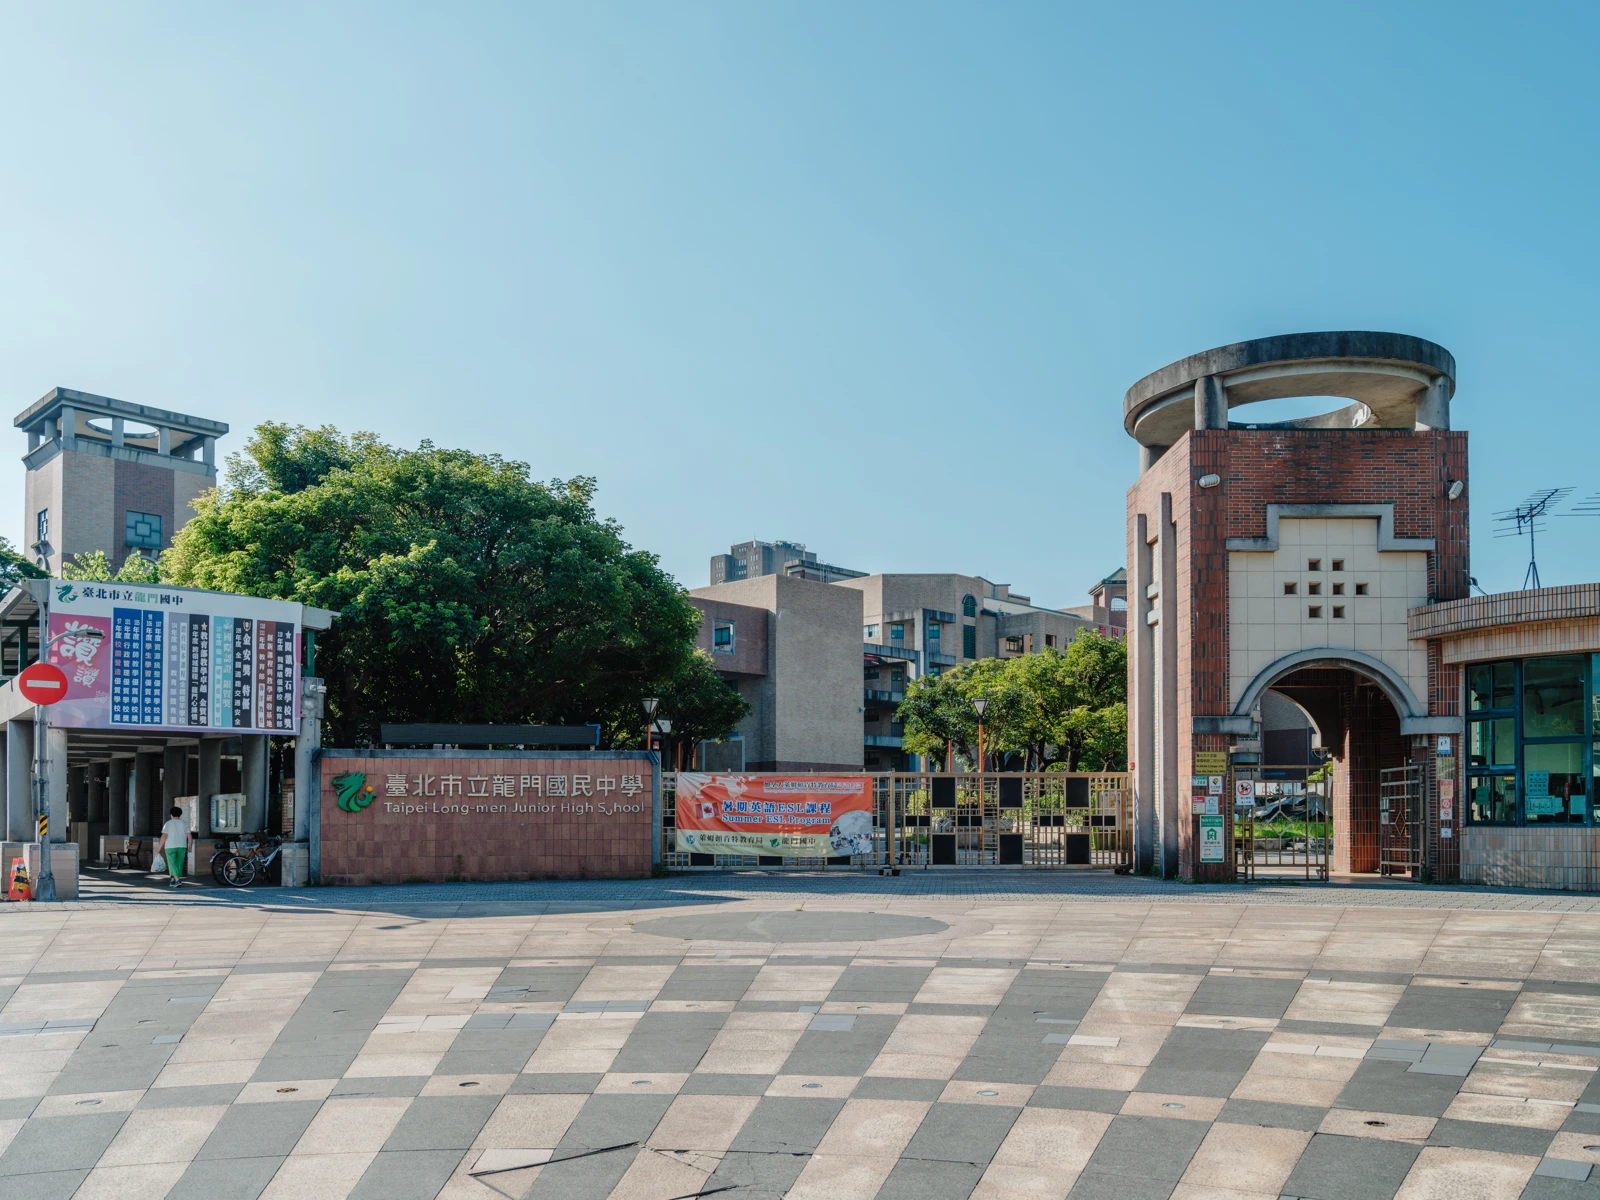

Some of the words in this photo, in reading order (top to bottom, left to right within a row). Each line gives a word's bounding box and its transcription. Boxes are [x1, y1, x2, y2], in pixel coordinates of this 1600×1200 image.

[82, 587, 183, 605] 臺北市立龍門國中
[242, 632, 251, 677] 金安獎
[241, 684, 251, 710] 特優
[385, 774, 644, 797] 臺北市立龍門國民中學
[384, 802, 428, 815] Taipei
[432, 802, 507, 815] Long-men
[511, 802, 557, 814] Junior
[560, 802, 594, 816] High
[598, 802, 645, 816] School
[722, 800, 832, 815] 暑期英語ESL課程
[722, 814, 763, 824] Summer
[766, 815, 786, 824] ESL
[788, 816, 831, 826] Program
